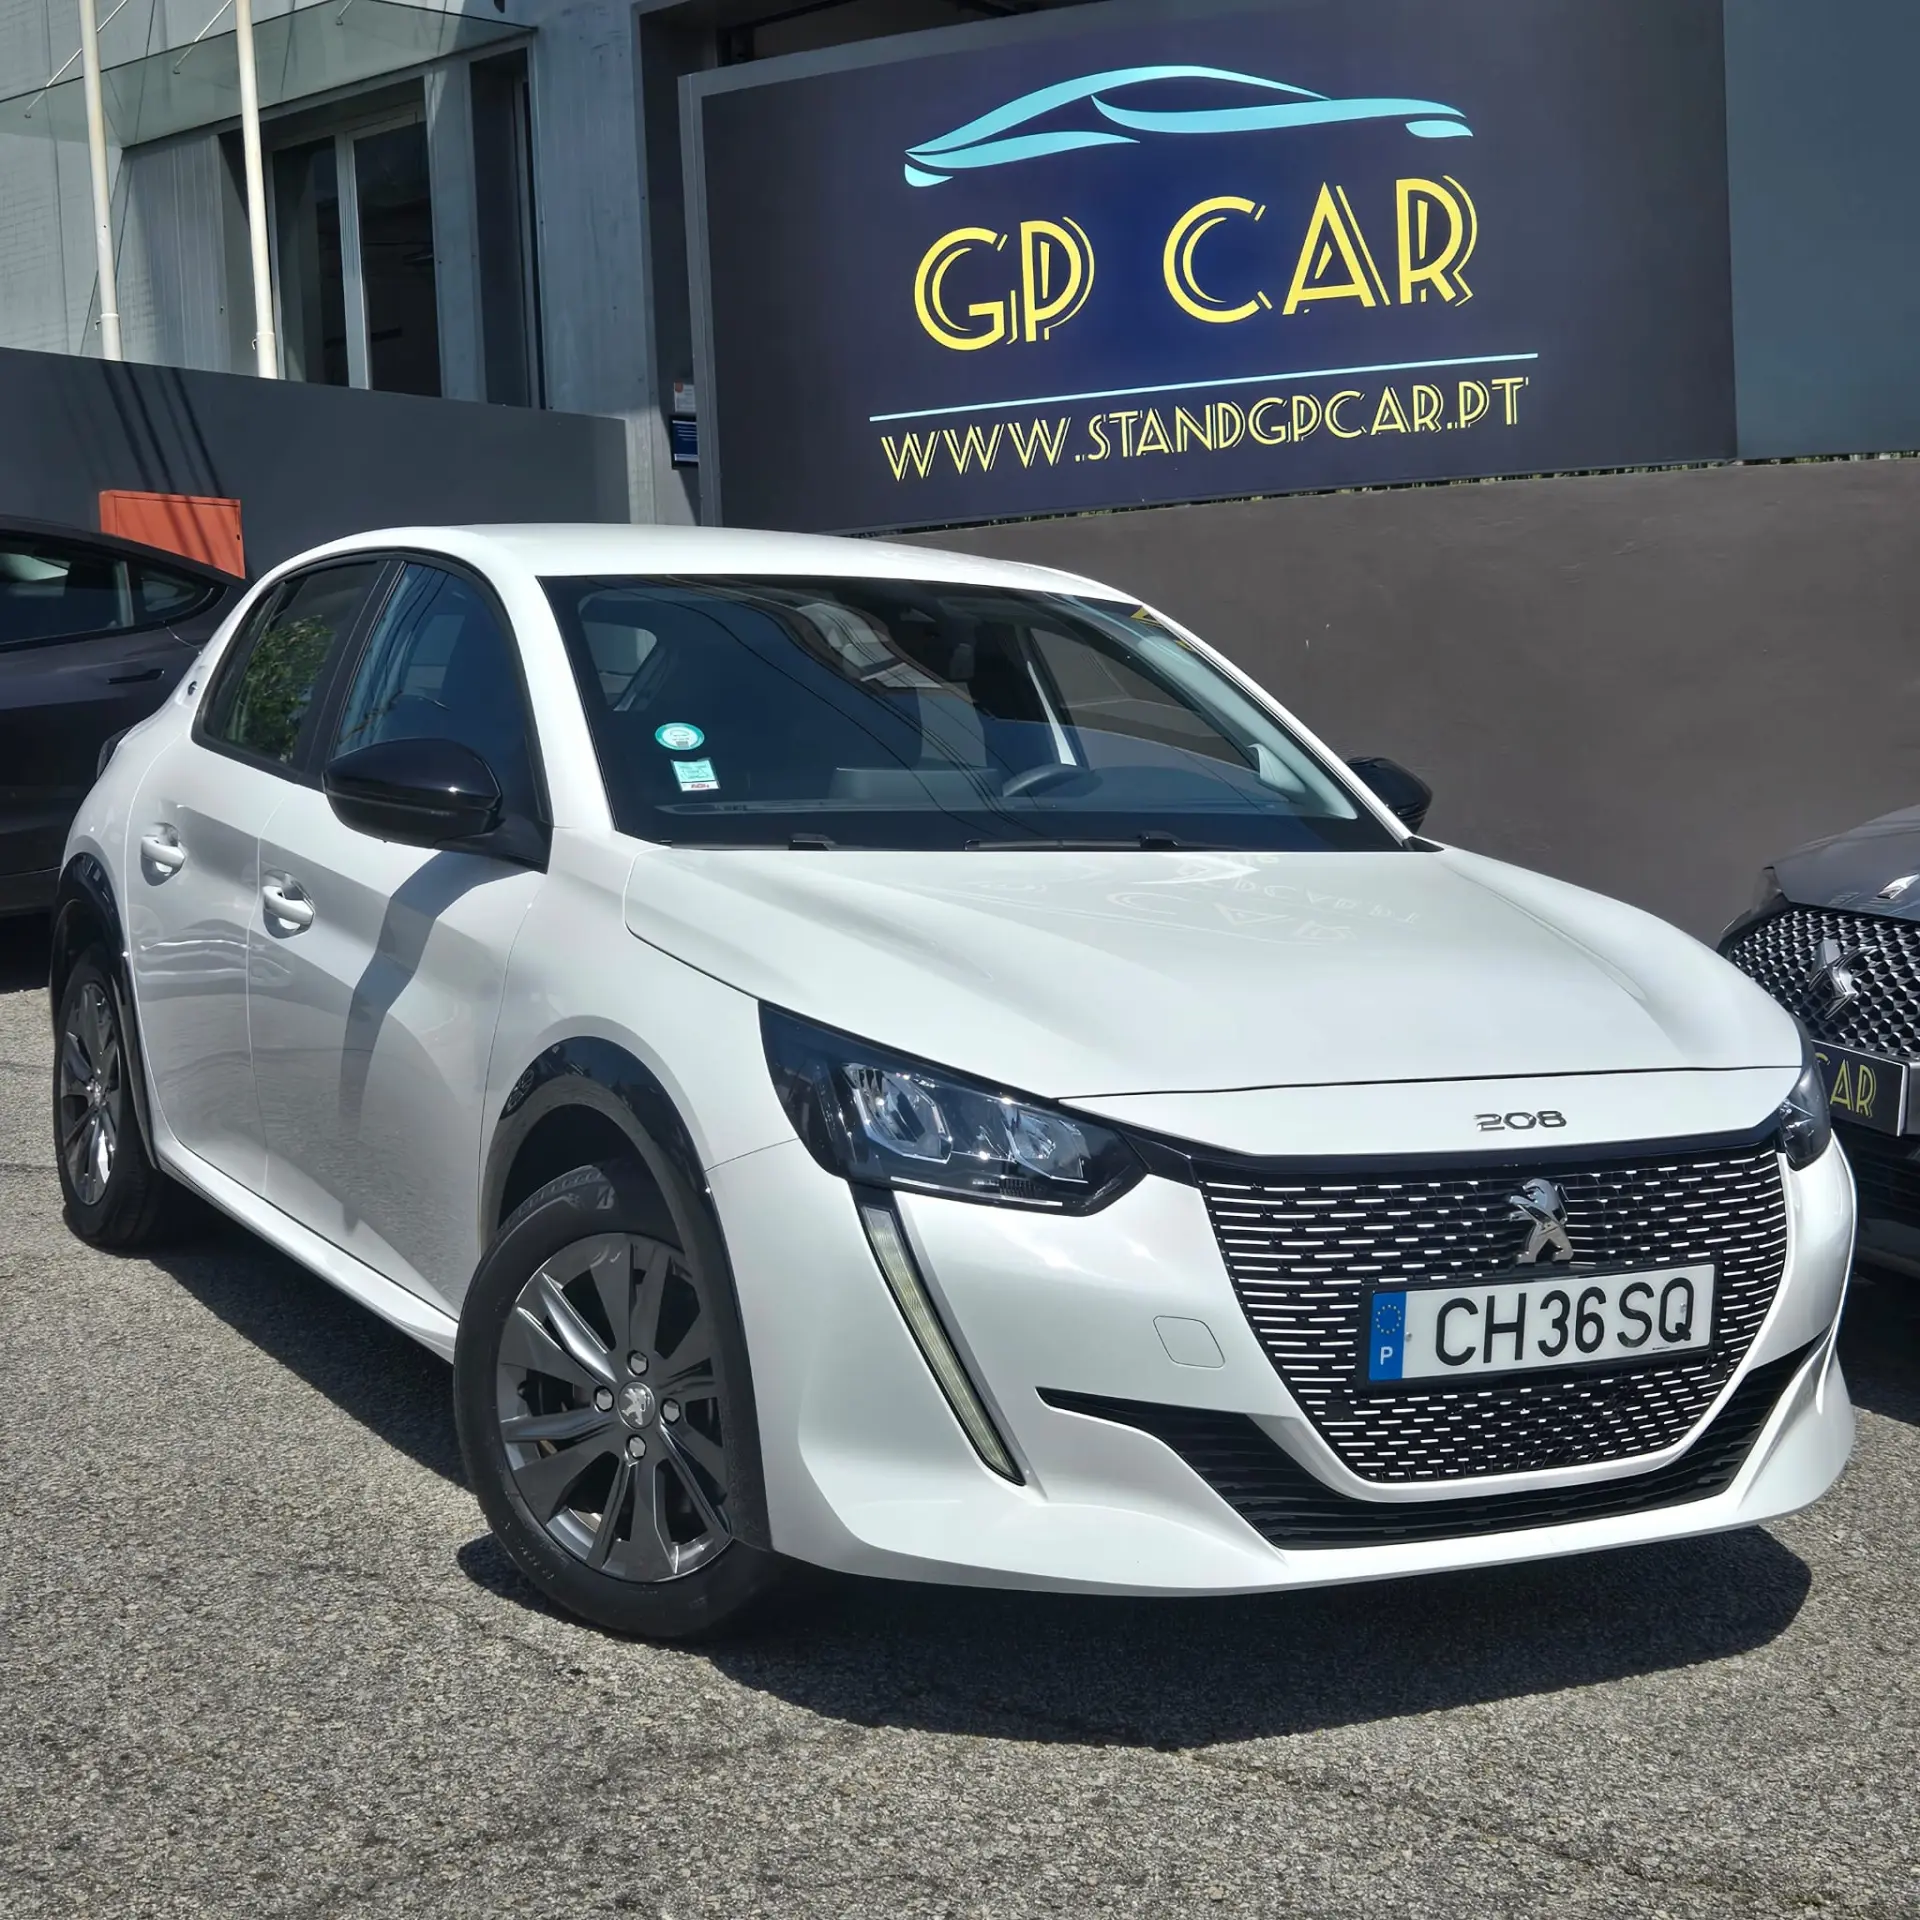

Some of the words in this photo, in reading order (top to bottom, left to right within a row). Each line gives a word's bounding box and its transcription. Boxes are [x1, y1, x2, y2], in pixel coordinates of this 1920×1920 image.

[914, 216, 1095, 351] GP
[1163, 174, 1478, 324] CAR
[880, 376, 1529, 481] WWW.STANDGPCAR.PT
[1474, 1110, 1567, 1131] 208
[1380, 1346, 1393, 1365] P
